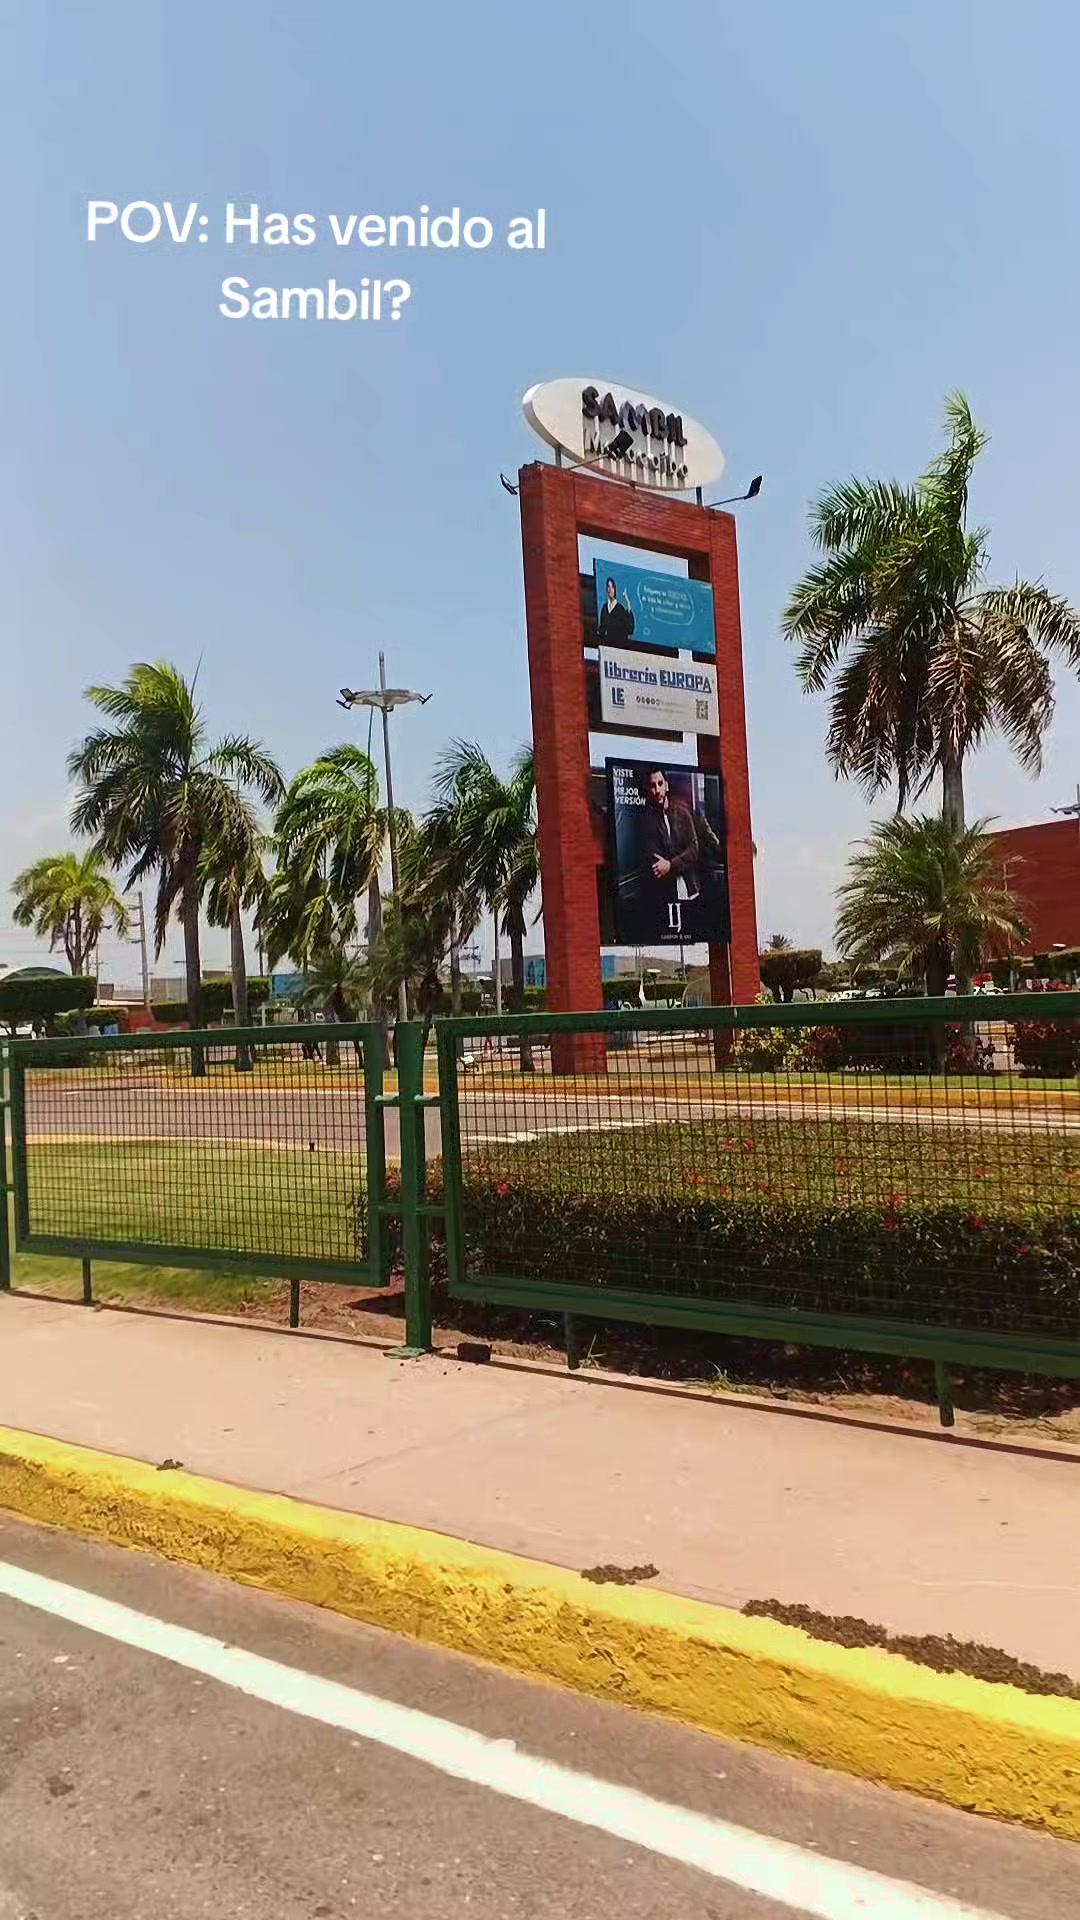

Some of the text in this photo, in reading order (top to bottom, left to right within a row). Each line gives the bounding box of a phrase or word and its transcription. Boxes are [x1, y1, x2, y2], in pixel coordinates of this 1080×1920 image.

[582, 385, 687, 447] SAMBIL
[659, 669, 712, 694] EUROPA
[611, 686, 625, 706] LE
[612, 767, 634, 778] VISTE
[614, 777, 624, 786] TU
[614, 785, 639, 797] MEJOR
